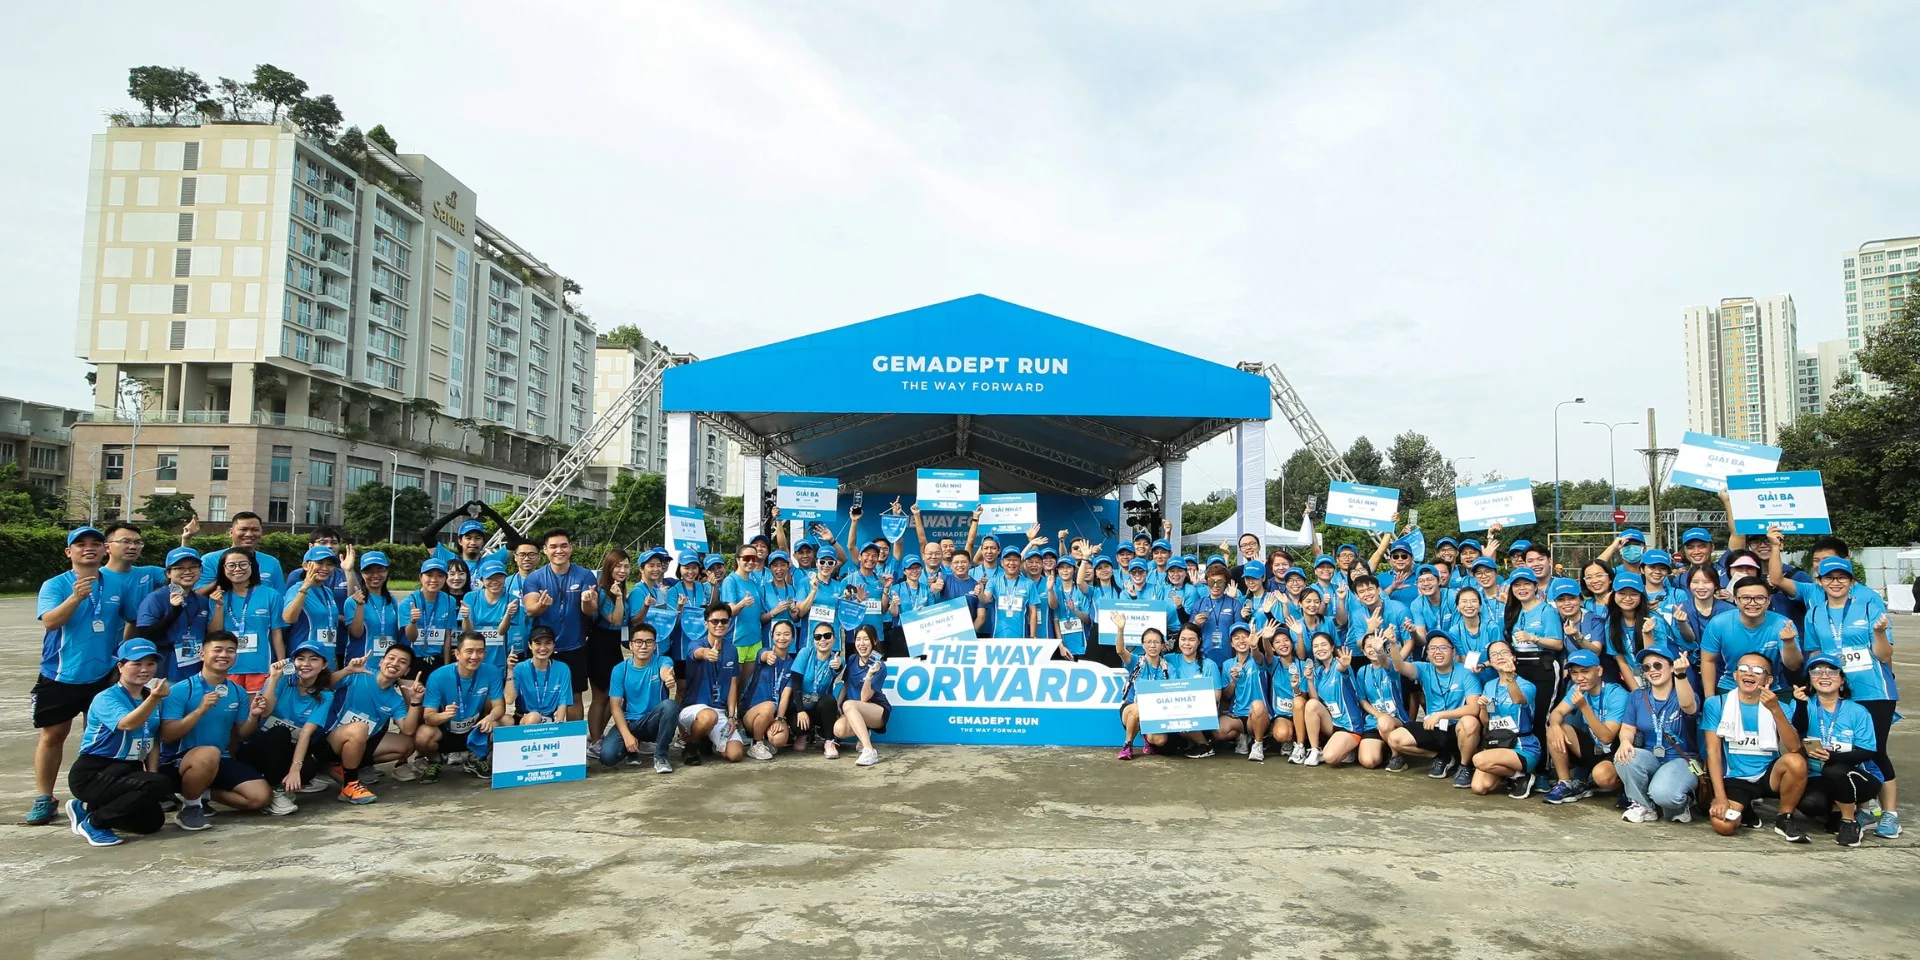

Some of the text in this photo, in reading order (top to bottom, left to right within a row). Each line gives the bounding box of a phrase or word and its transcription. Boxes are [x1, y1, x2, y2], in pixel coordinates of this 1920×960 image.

[872, 355, 1068, 375] GEMADEPT RUN
[902, 381, 1044, 392] THE WAY FORWARD
[1757, 491, 1794, 501] GIẢI BA
[928, 645, 1044, 665] THE WAY
[882, 666, 1097, 703] FORWARD
[948, 716, 1039, 725] GEMADEPT RUN
[521, 742, 541, 752] GIẢI
